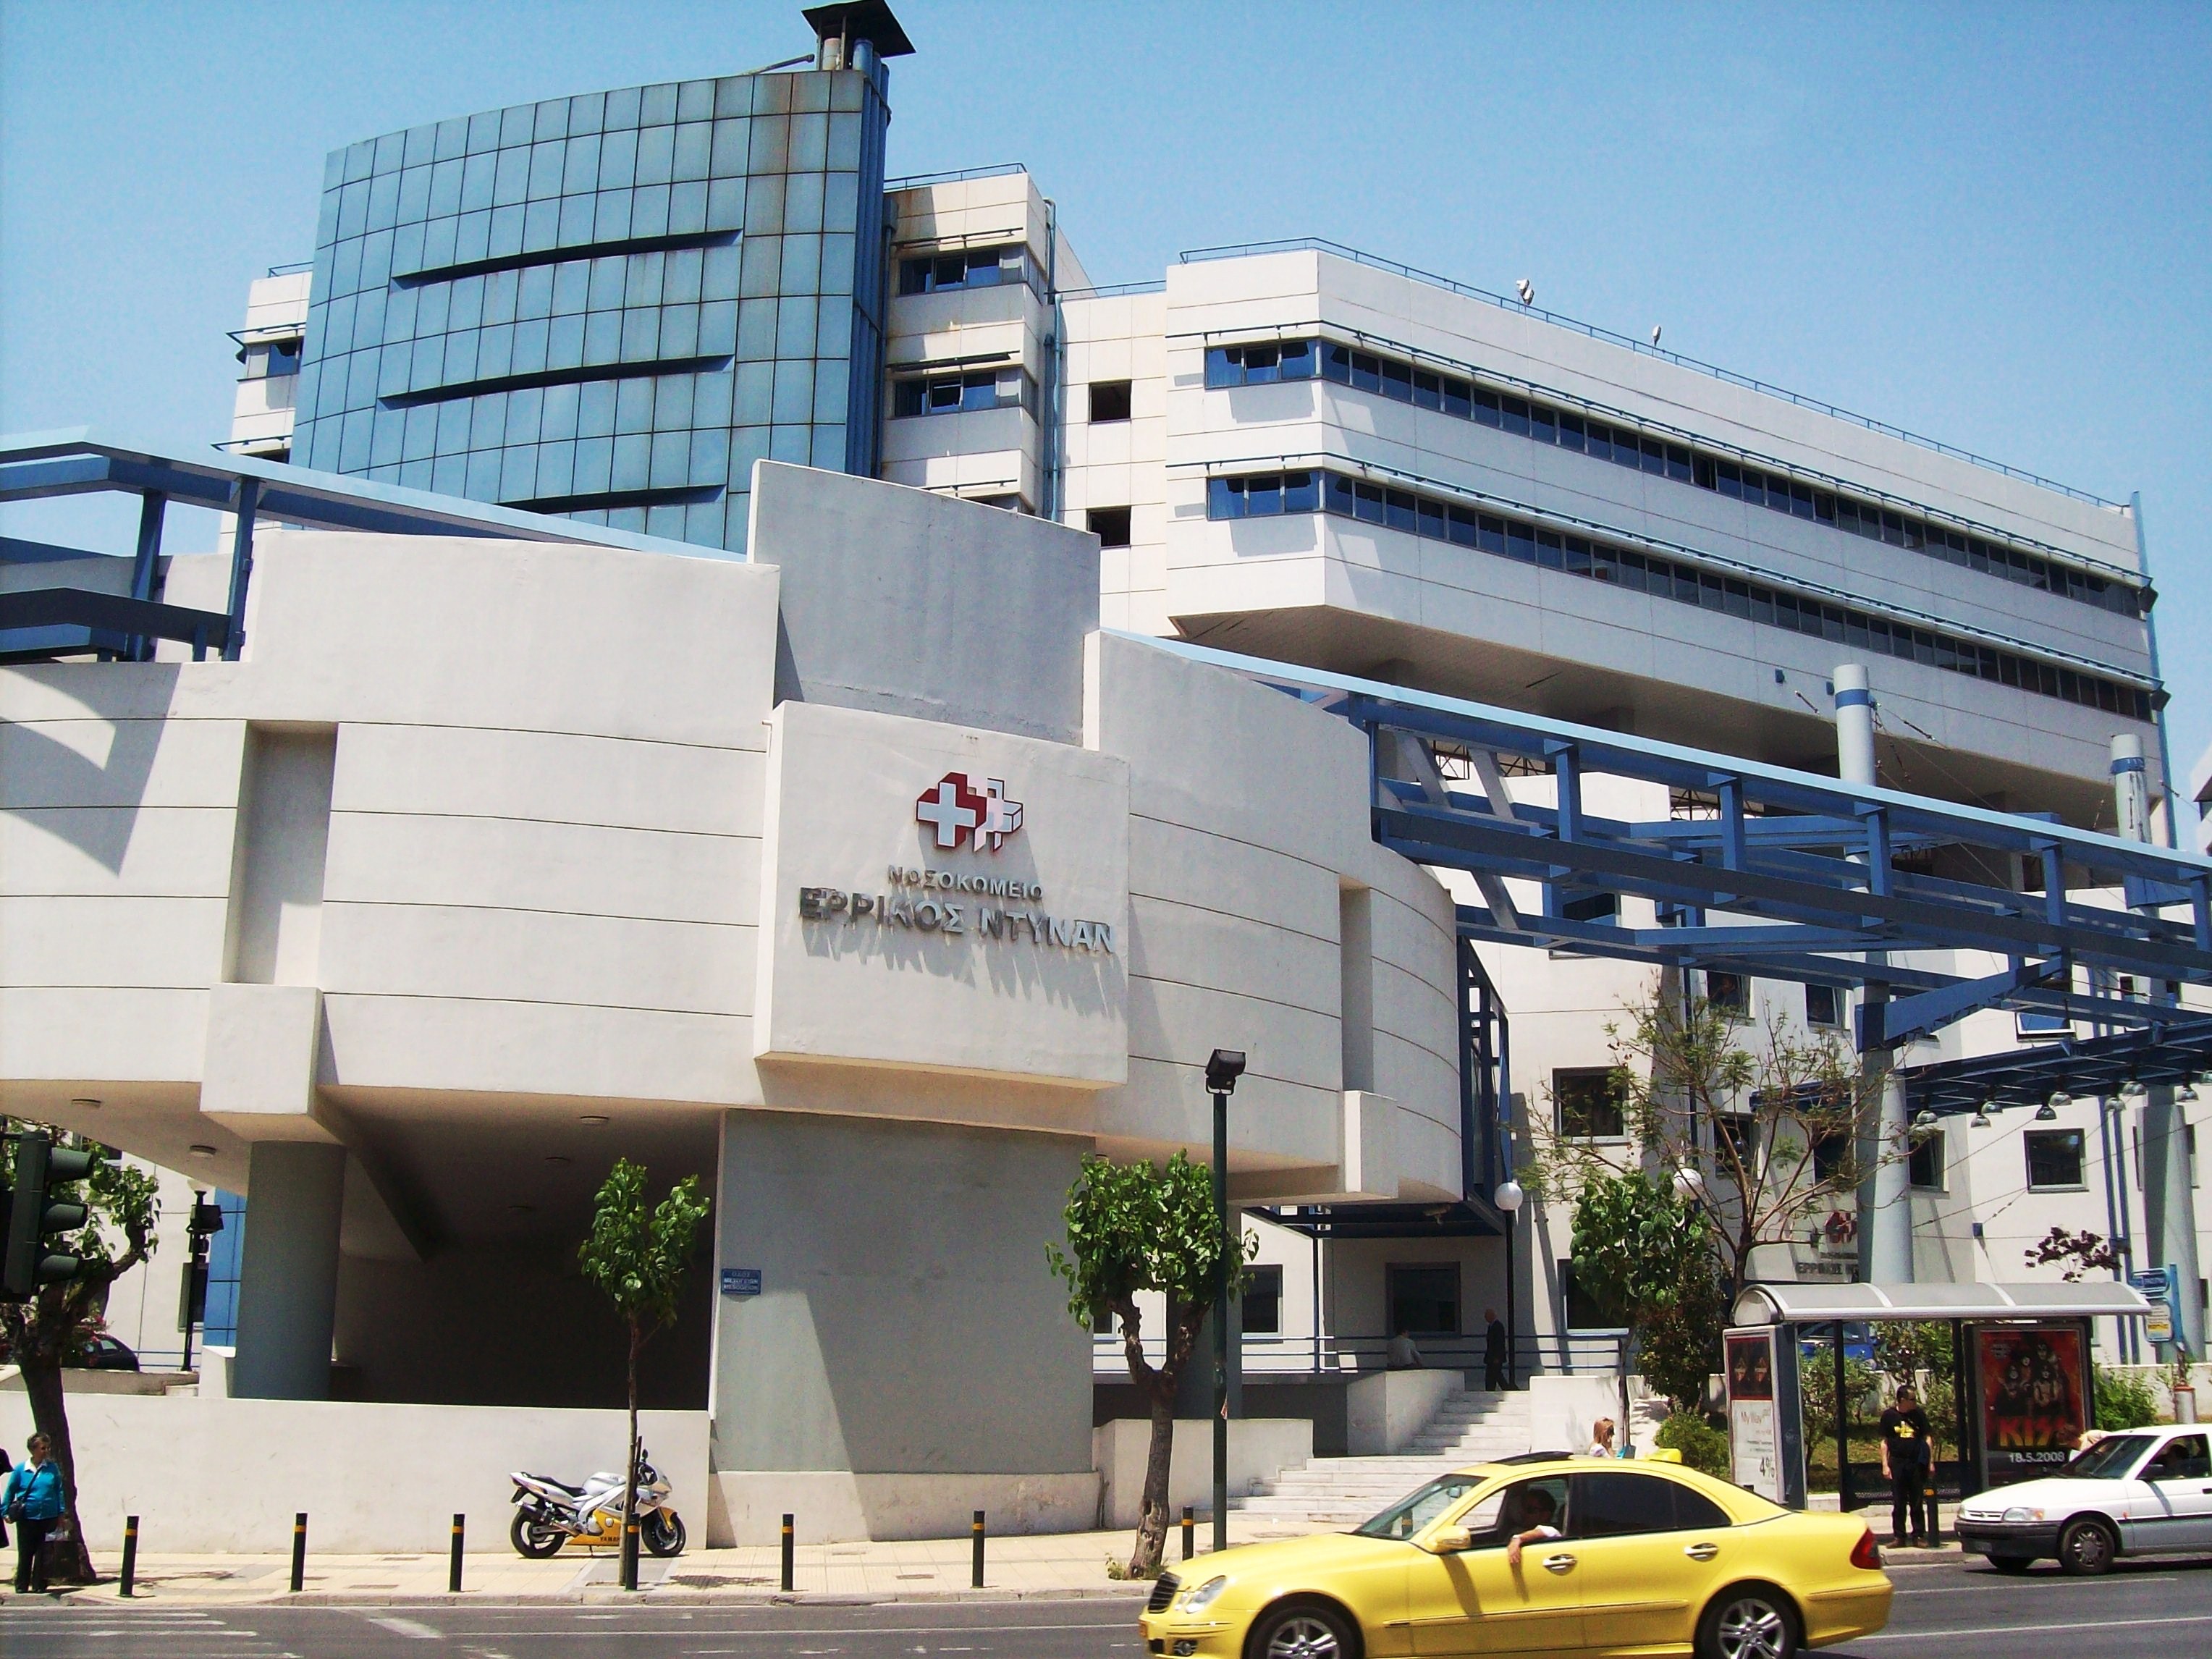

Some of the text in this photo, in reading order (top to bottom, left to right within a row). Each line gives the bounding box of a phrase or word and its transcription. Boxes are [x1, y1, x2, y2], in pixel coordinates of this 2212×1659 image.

[888, 865, 1042, 900] ΝΟΣΟΚΟΜΕΙΟ
[800, 887, 1116, 953] ΕΡΡΙΚΟΣ ΝΤΥΝΑΝ
[2009, 1451, 2065, 1463] 18.5.2008
